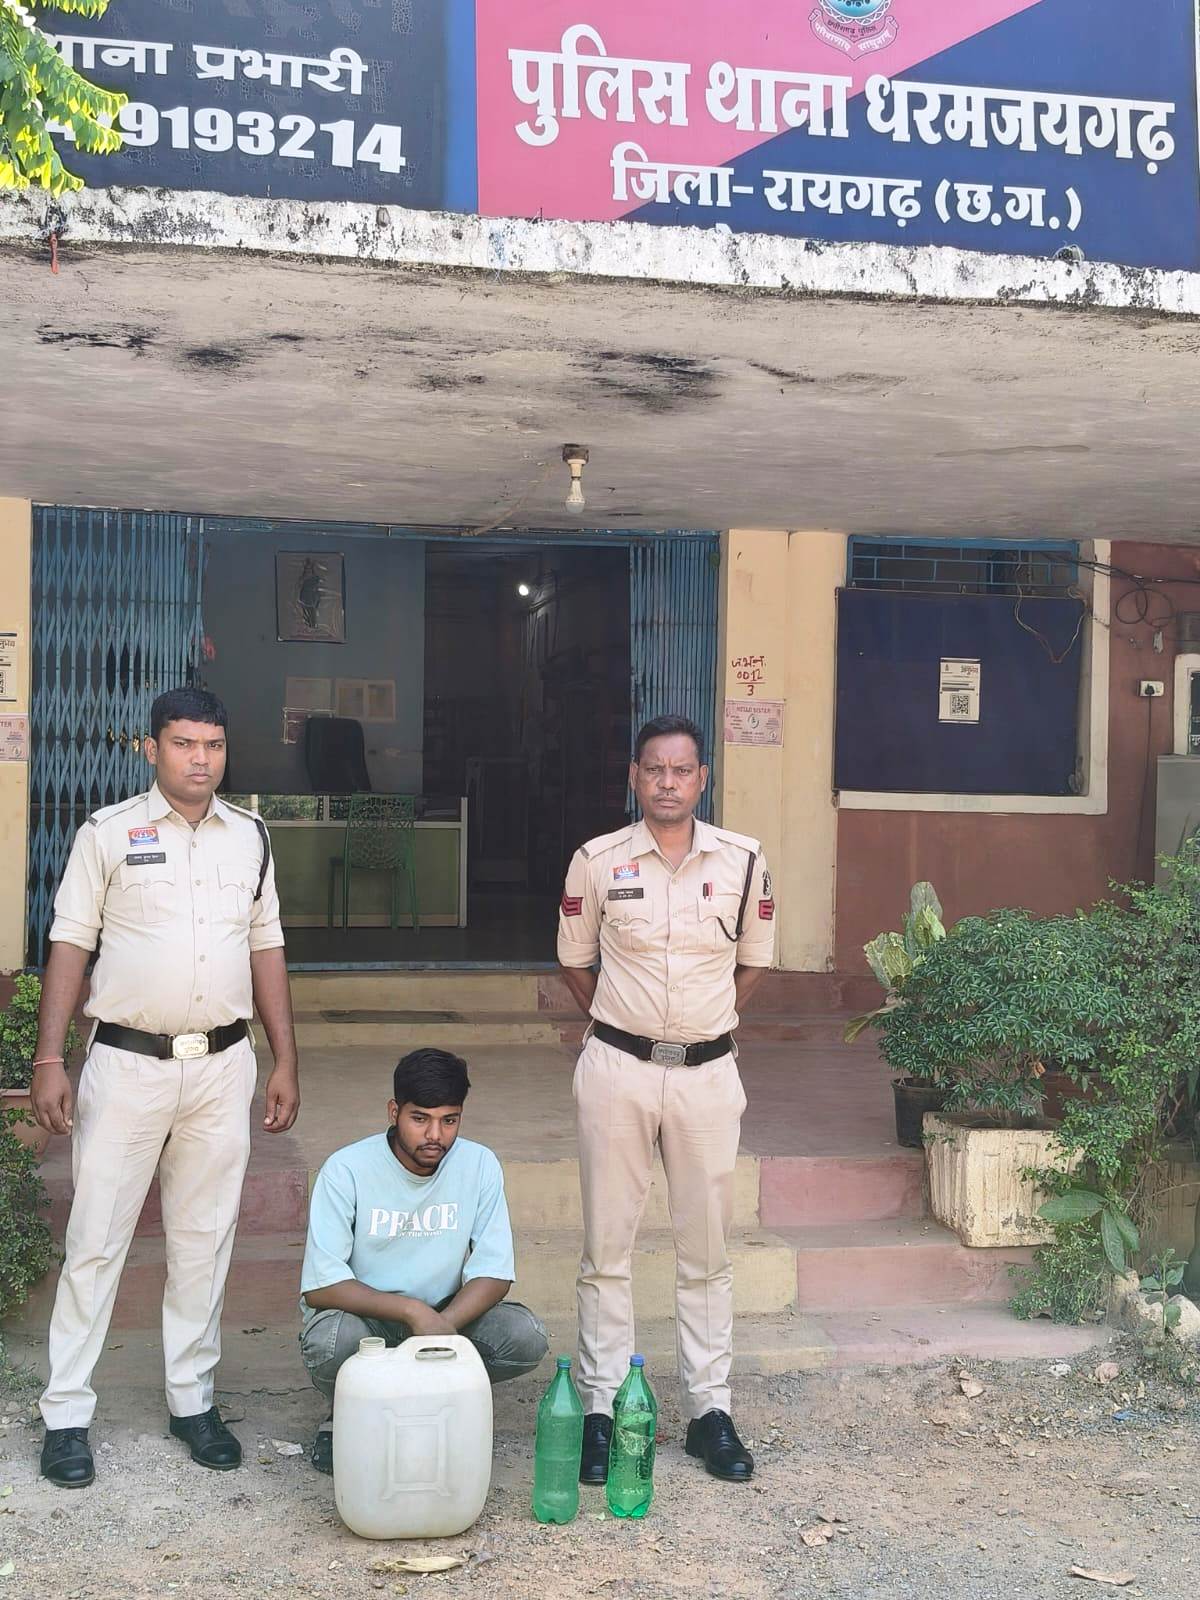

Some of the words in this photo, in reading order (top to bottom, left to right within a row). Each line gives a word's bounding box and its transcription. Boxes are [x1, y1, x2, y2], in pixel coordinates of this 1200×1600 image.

[193, 44, 368, 96] प्रभारी
[508, 23, 692, 147] पुलिस
[705, 60, 853, 138] थाना
[864, 73, 1176, 175] धरमजयगढ़
[762, 169, 923, 228] रायगढ़
[747, 684, 755, 697] 3
